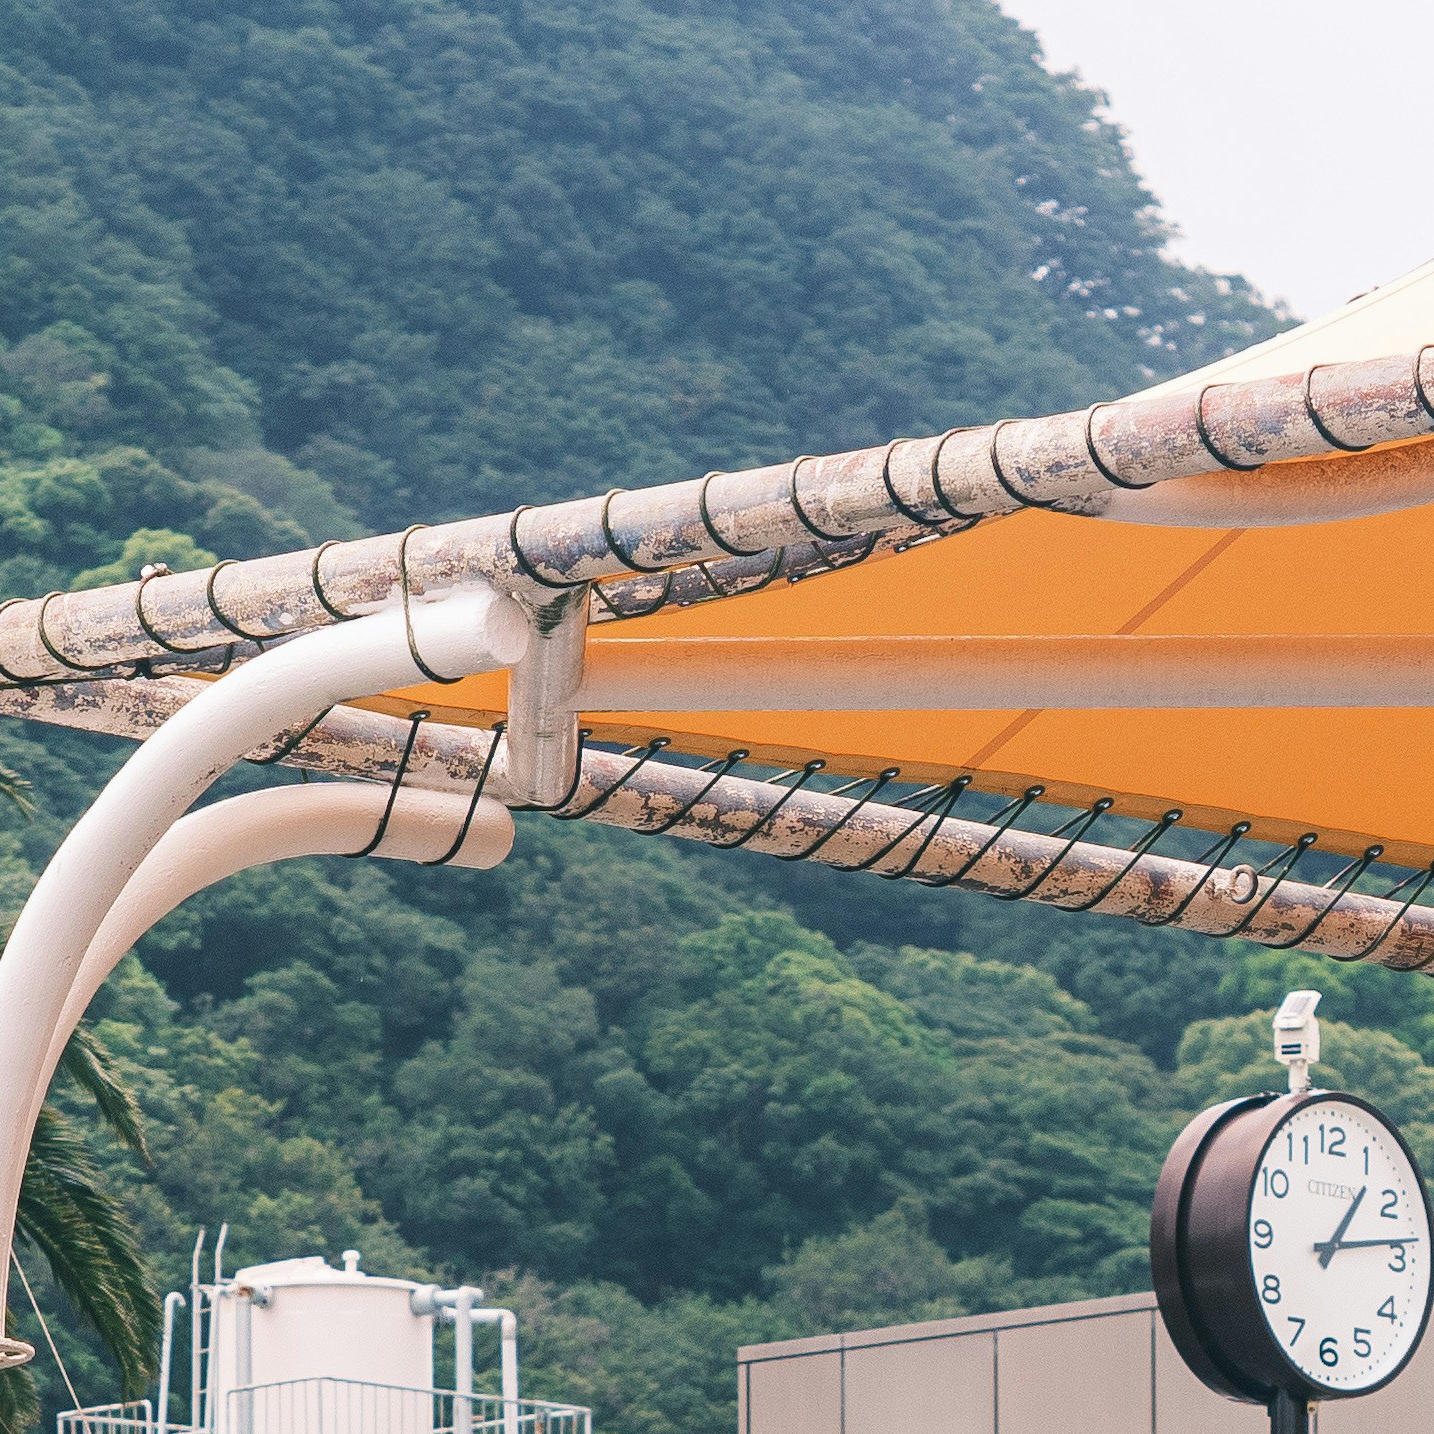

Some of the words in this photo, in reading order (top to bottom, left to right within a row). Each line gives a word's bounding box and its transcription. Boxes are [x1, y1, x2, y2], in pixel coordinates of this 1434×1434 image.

[1287, 1132, 1310, 1165] 11
[1319, 1123, 1347, 1157] 12
[1362, 1145, 1370, 1176] 1
[1262, 1166, 1290, 1199] 10
[1307, 1179, 1359, 1201] CITIZEN
[1380, 1189, 1399, 1220] 2
[1253, 1219, 1274, 1249] 9
[1387, 1243, 1407, 1273] 3
[1261, 1274, 1282, 1304] 8
[1376, 1295, 1398, 1325] 4
[1287, 1316, 1306, 1347] 7
[1353, 1327, 1372, 1358] 5
[1319, 1337, 1339, 1367] 6
